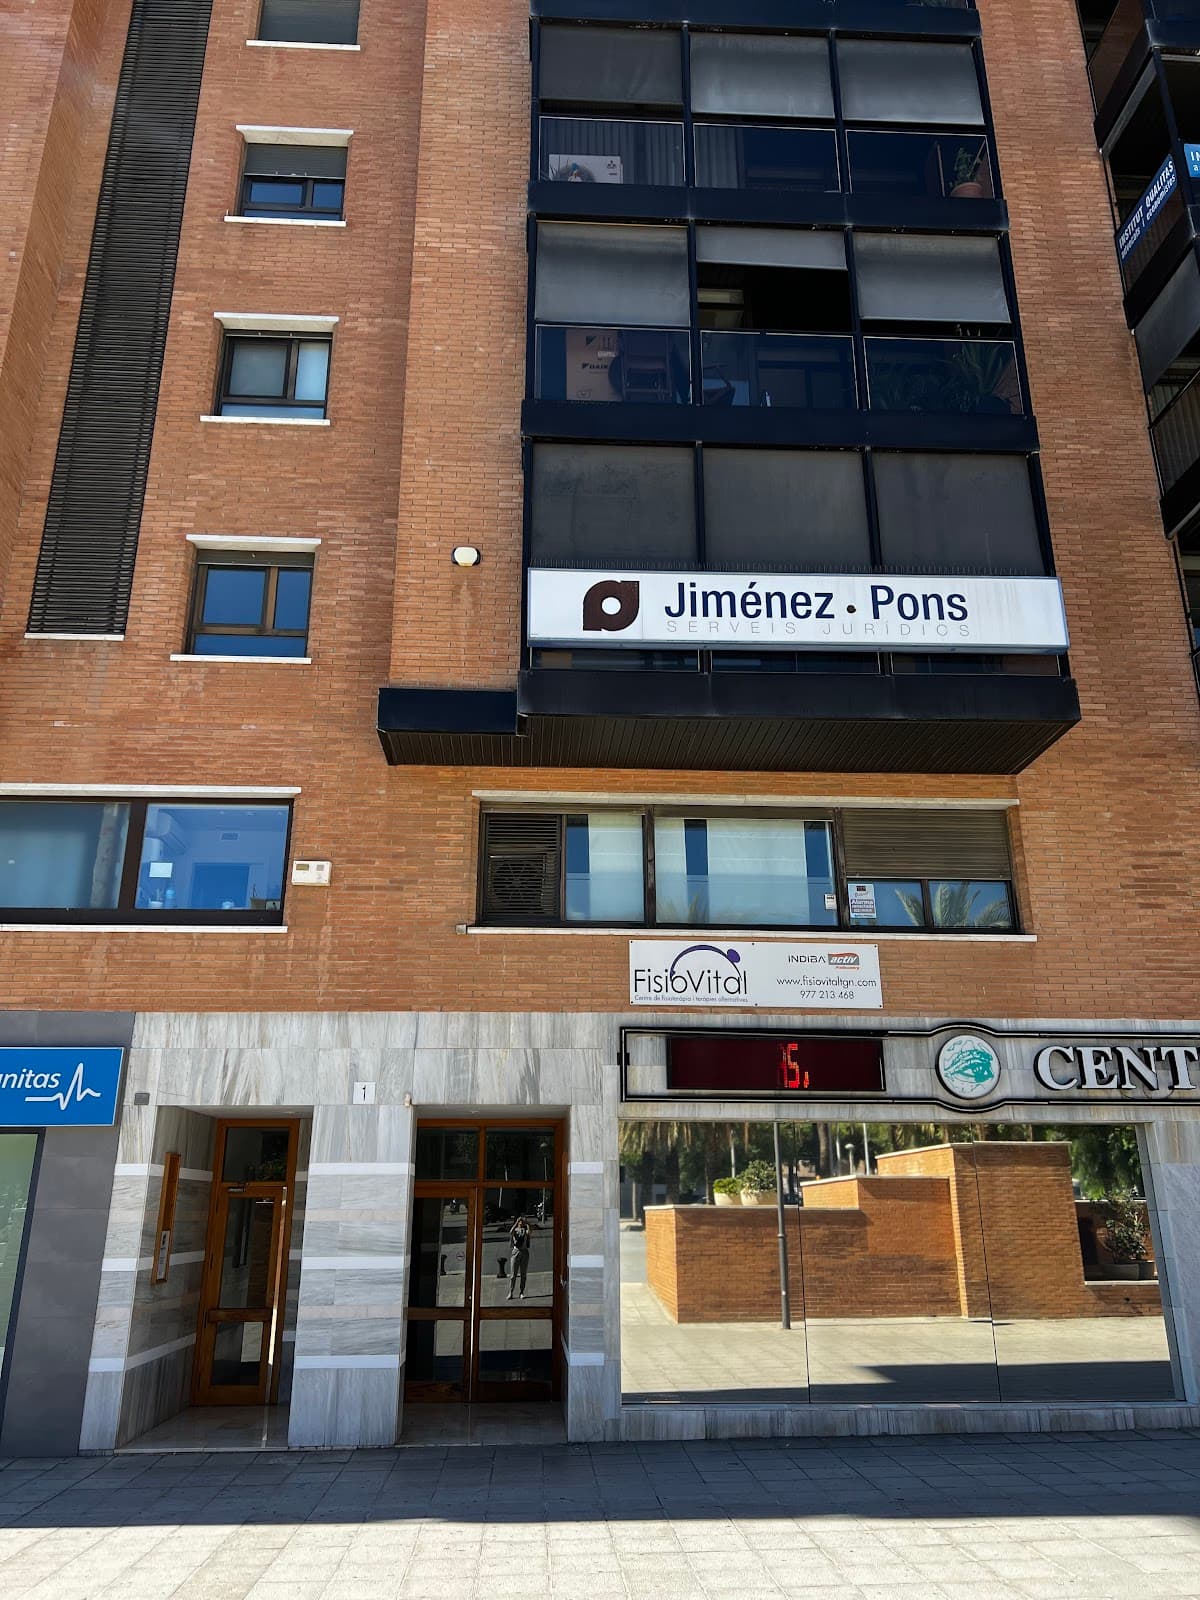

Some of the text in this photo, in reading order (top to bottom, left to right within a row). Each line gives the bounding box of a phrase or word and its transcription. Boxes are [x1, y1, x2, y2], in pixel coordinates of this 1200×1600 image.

[1119, 160, 1173, 249] INSTITUT QUALITAS
[664, 581, 969, 621] Jiménez Pons
[666, 620, 970, 637] SERVEIS JURÍDICS
[788, 955, 826, 963] INDIBA
[634, 968, 747, 995] FisioVital
[776, 975, 877, 989] www.fisiovitaltgn.com
[800, 990, 855, 1000] 977 213 468
[1034, 1045, 1200, 1090] CENT
[361, 1084, 367, 1101] 1
